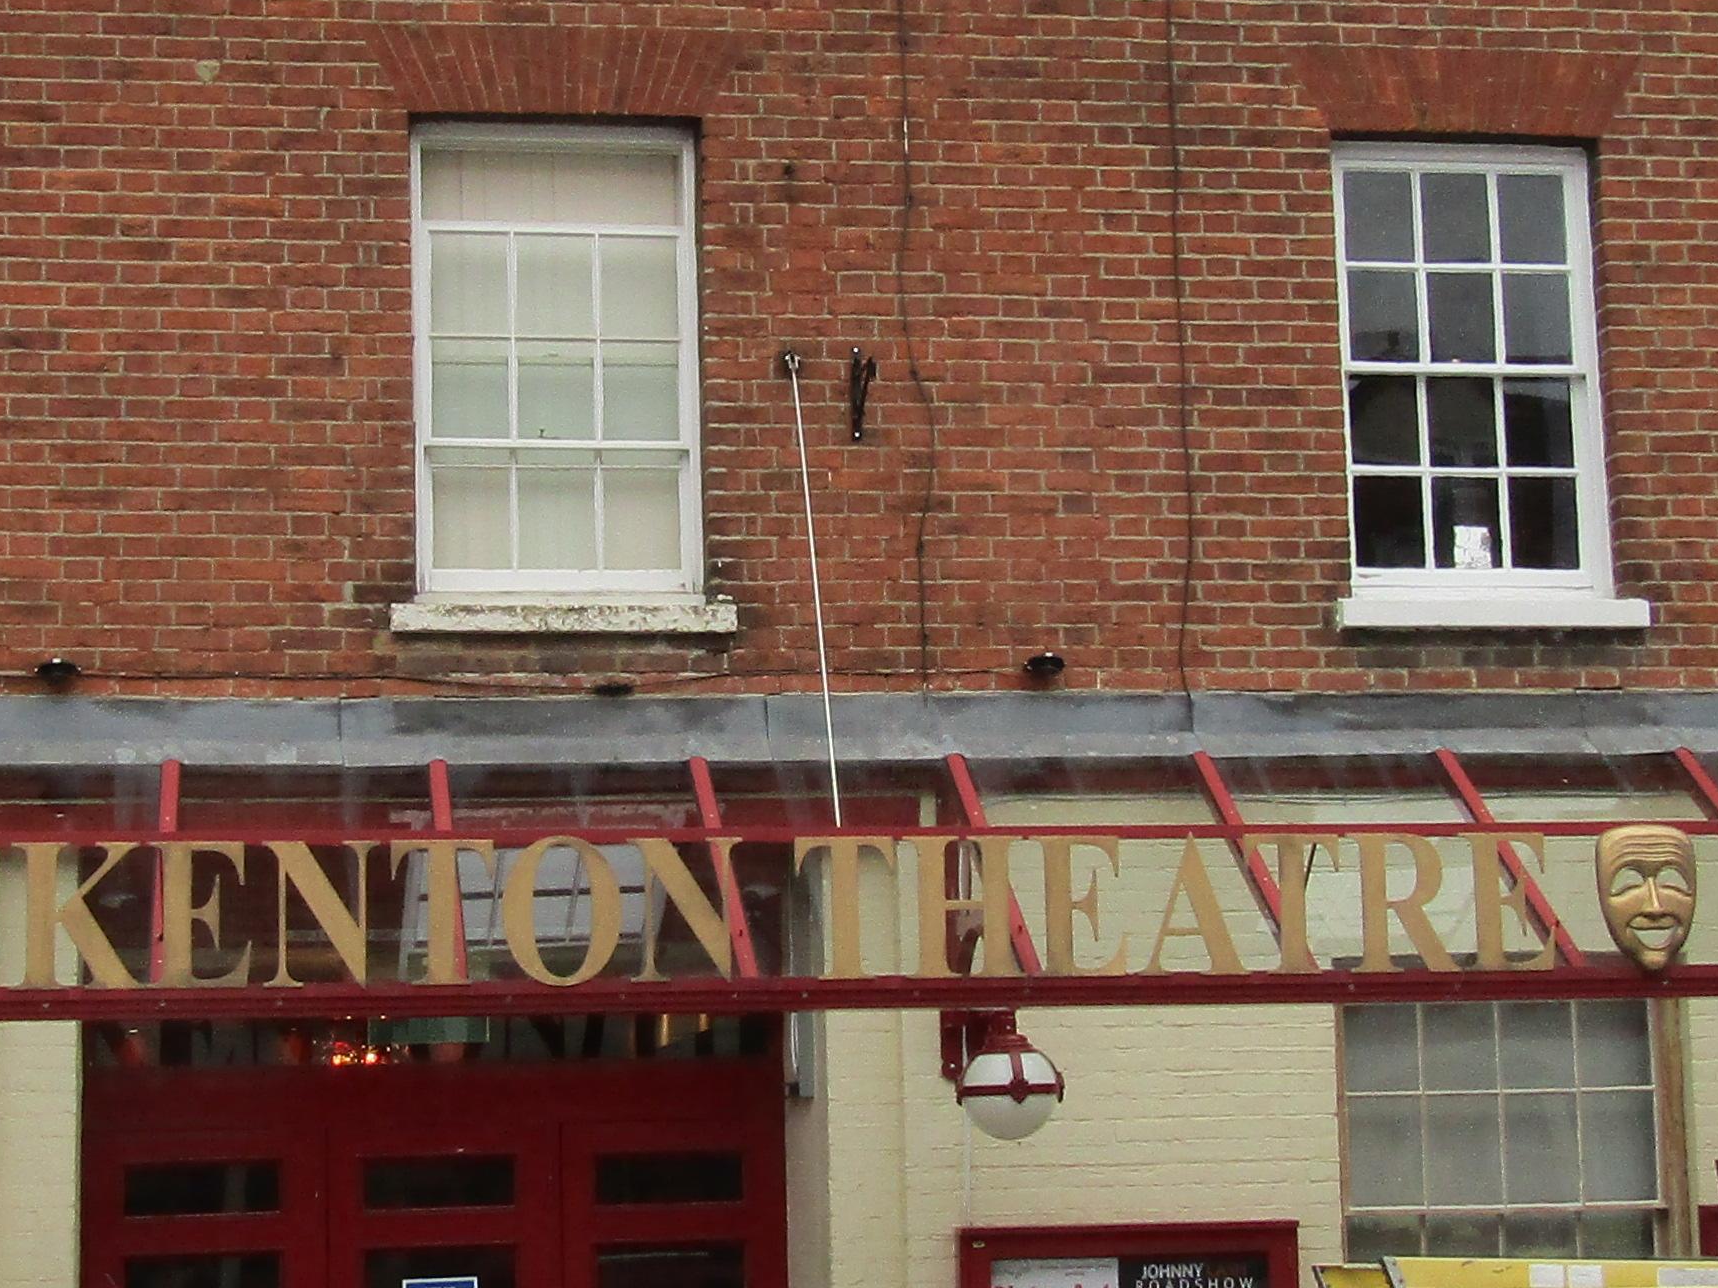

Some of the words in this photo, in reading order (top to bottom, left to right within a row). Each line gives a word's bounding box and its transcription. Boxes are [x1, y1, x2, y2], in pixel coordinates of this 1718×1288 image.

[12, 835, 745, 989] KENTON
[794, 830, 1557, 981] THEATRE
[1141, 1263, 1203, 1280] JOHNNY
